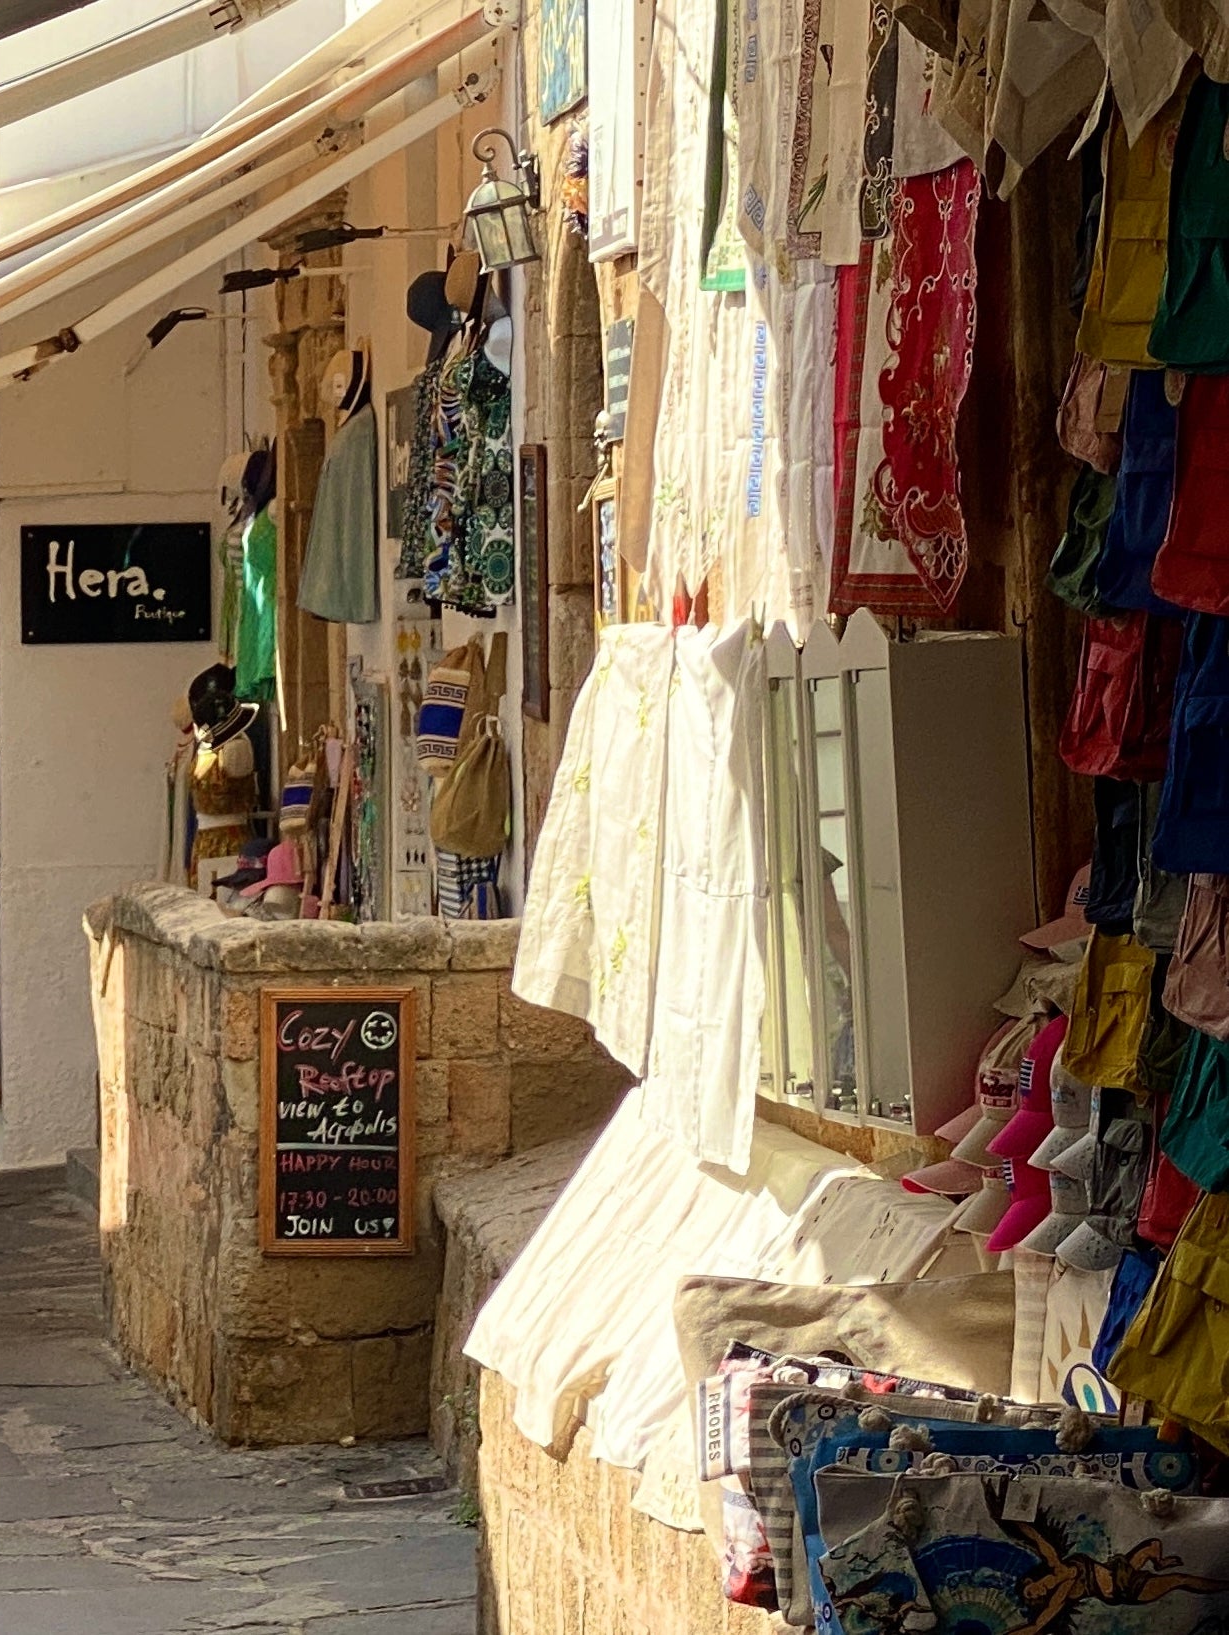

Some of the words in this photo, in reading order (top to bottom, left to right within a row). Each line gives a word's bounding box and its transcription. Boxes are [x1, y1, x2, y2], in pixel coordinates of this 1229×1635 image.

[46, 539, 166, 603] Hera.
[277, 1009, 356, 1065] Cozy
[332, 1096, 364, 1117] to
[280, 1152, 342, 1173] HAPPY
[348, 1155, 397, 1171] HOUR
[279, 1190, 327, 1213] 17:30
[347, 1187, 397, 1207] 20:00
[284, 1215, 334, 1236] JOIN
[708, 1392, 721, 1461] RHODES
